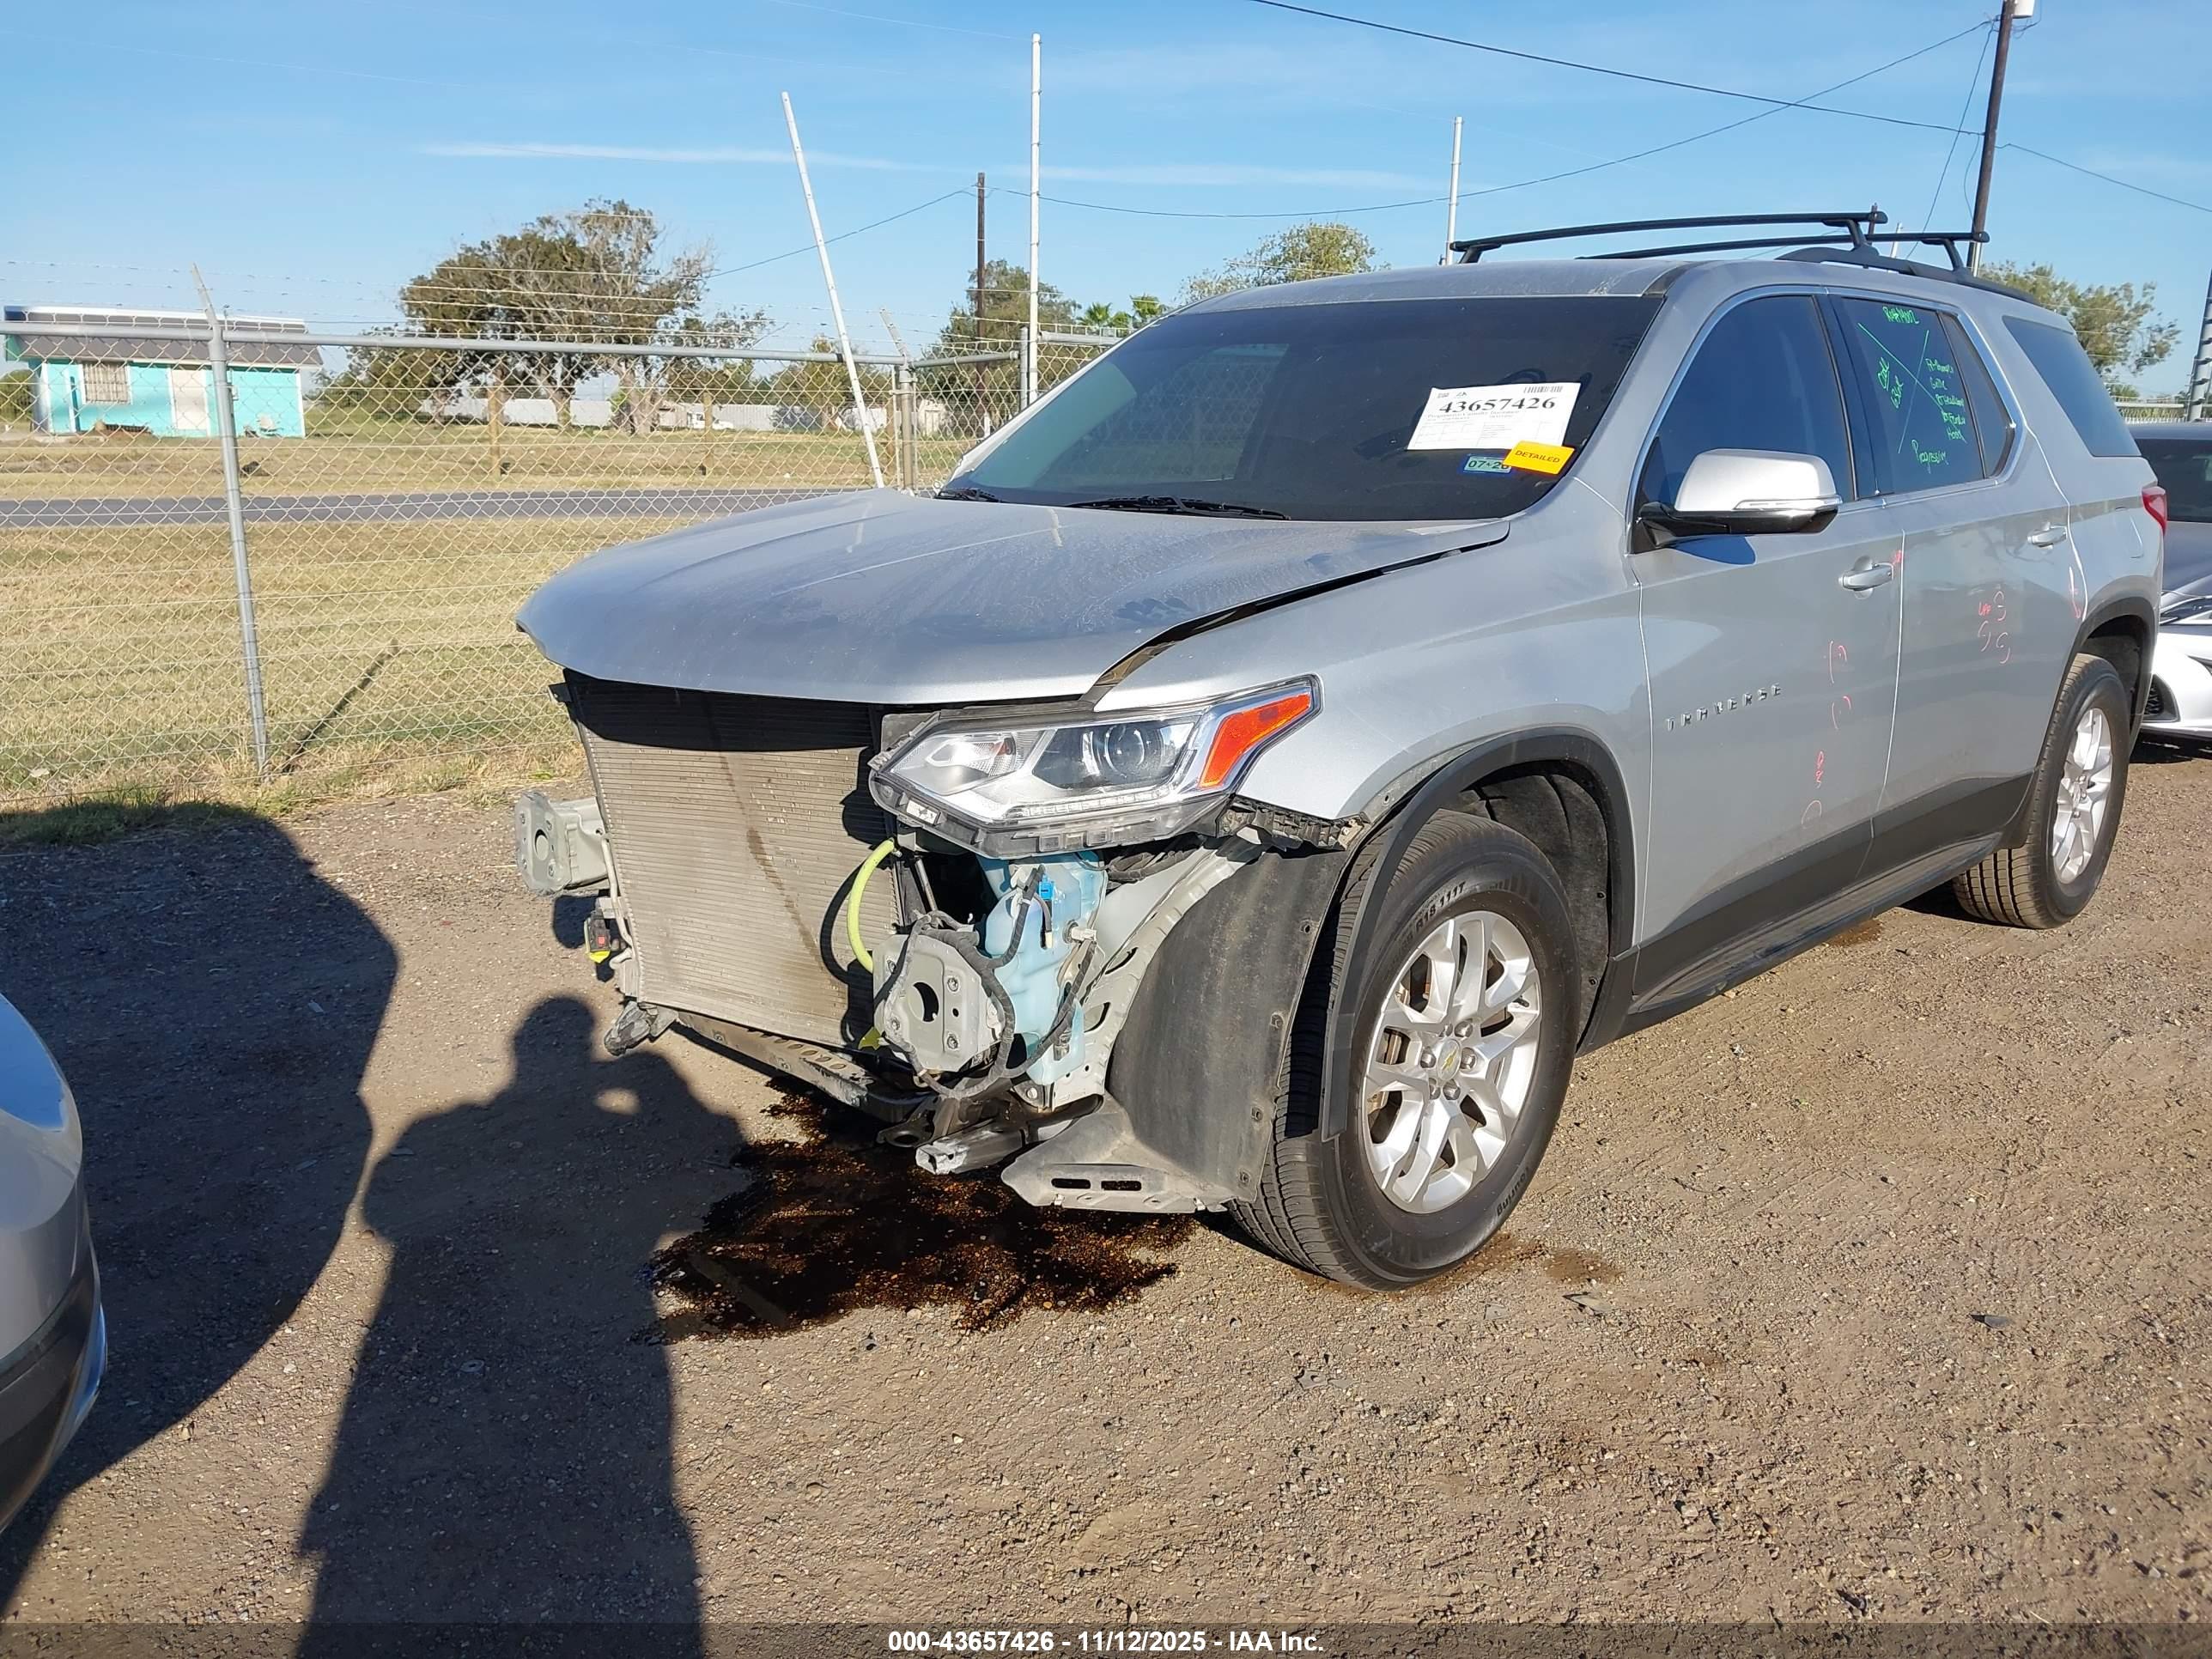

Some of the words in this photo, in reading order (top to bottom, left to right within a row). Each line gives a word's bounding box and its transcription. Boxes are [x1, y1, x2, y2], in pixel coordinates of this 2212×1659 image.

[1438, 397, 1558, 414] 43657426
[1514, 450, 1561, 464] DETAILED
[1666, 682, 1783, 732] TRAVERSE
[1497, 1167, 1528, 1217] ouring
